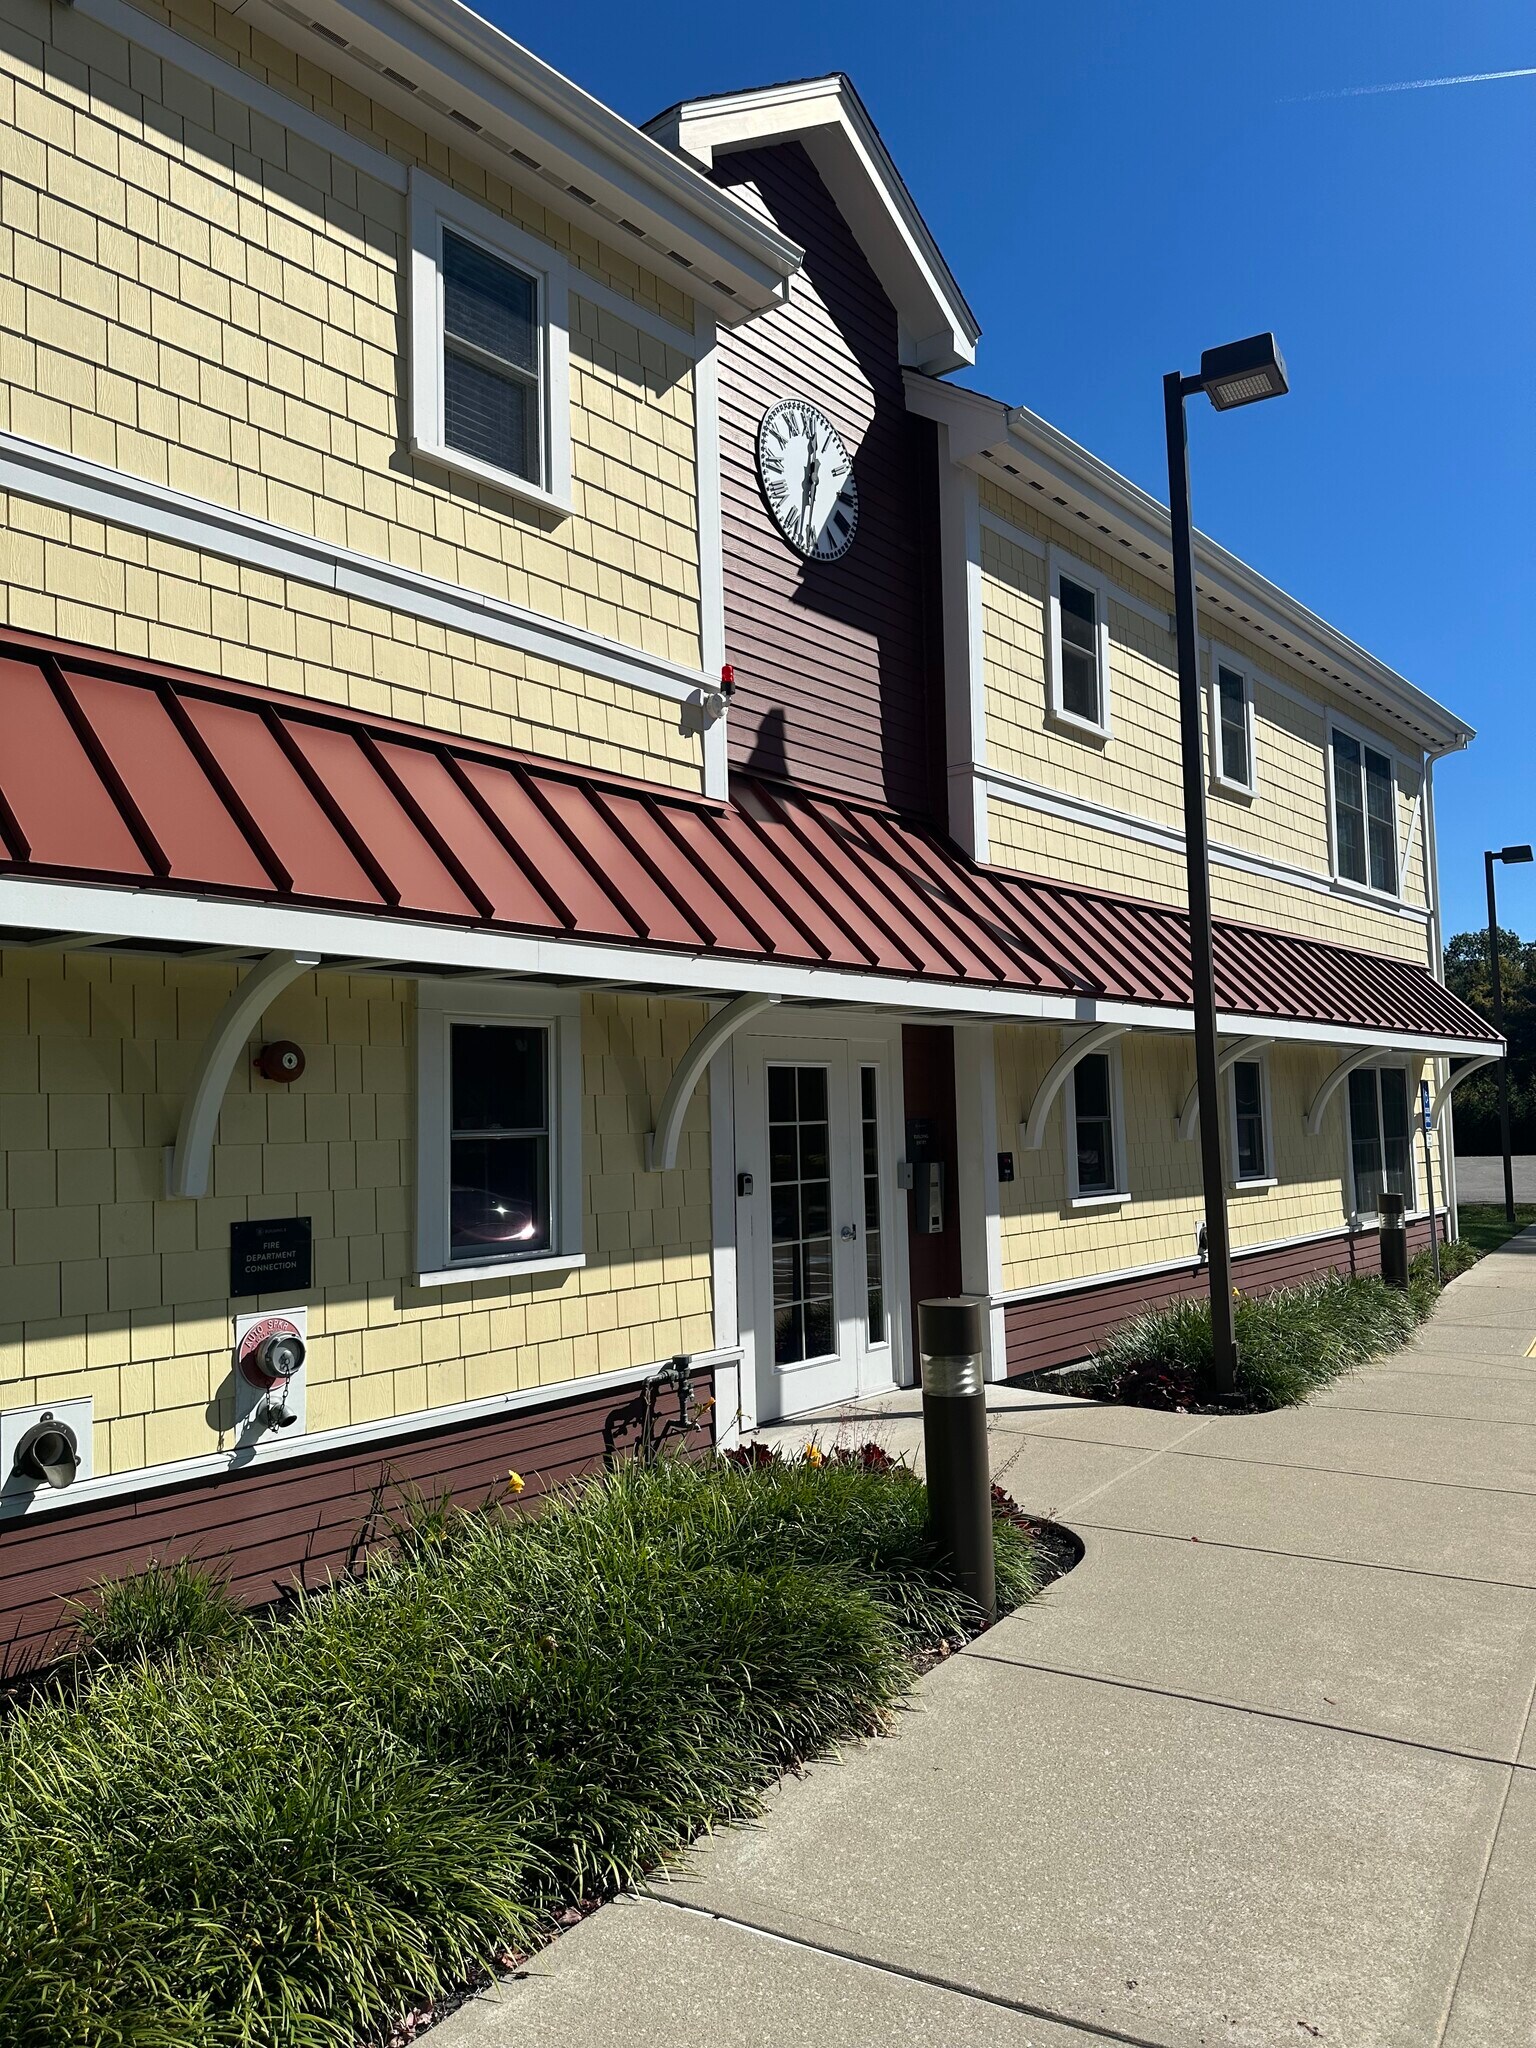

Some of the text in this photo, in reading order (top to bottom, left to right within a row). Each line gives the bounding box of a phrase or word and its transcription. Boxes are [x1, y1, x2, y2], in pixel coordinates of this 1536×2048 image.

[263, 1241, 281, 1249] FIRE
[246, 1250, 297, 1262] DEPARTMENT
[245, 1261, 297, 1273] CONNECTION
[244, 1325, 264, 1349] AUTO
[267, 1319, 289, 1330] SPKR
